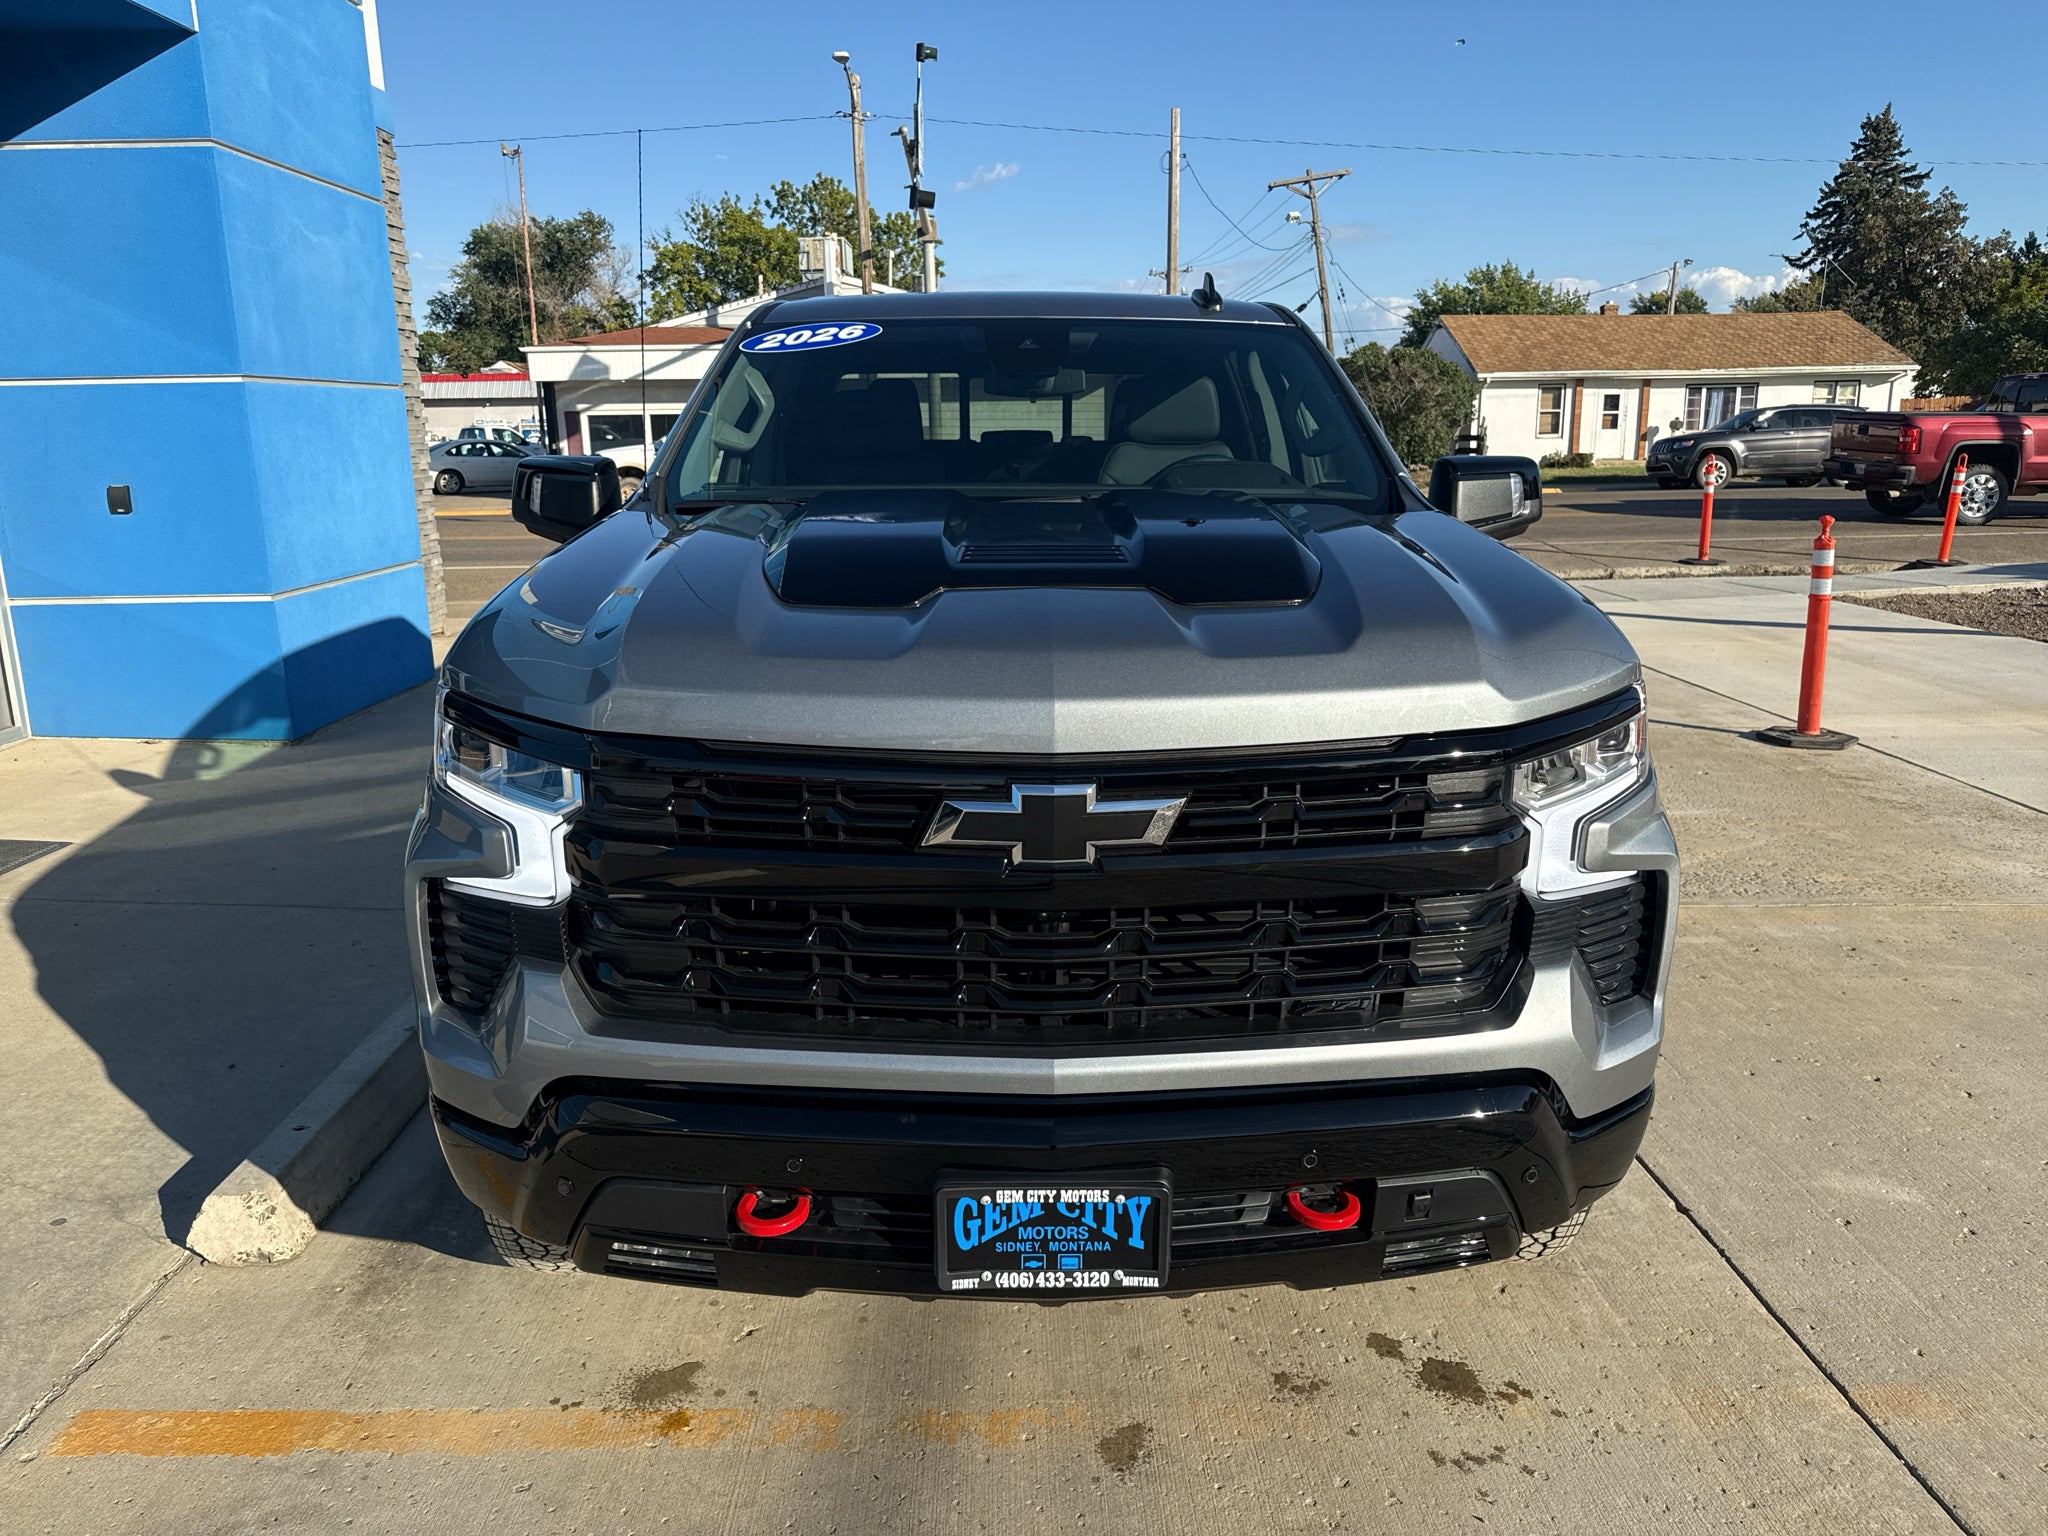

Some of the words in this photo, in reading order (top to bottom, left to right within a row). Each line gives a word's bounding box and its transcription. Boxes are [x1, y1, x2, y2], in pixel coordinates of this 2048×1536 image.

[754, 325, 867, 350] 2026
[996, 1190, 1023, 1203] GEM
[1027, 1190, 1057, 1203] CITY
[1060, 1190, 1109, 1203] MOTORS
[954, 1197, 1045, 1250] GEM
[1057, 1196, 1151, 1249] CITY
[1018, 1226, 1089, 1239] MOTORS
[995, 1241, 1042, 1252] SIDNEY,
[1049, 1241, 1111, 1251] MONTANA
[952, 1278, 979, 1289] SIDNEY
[1122, 1276, 1159, 1287] MONTANA
